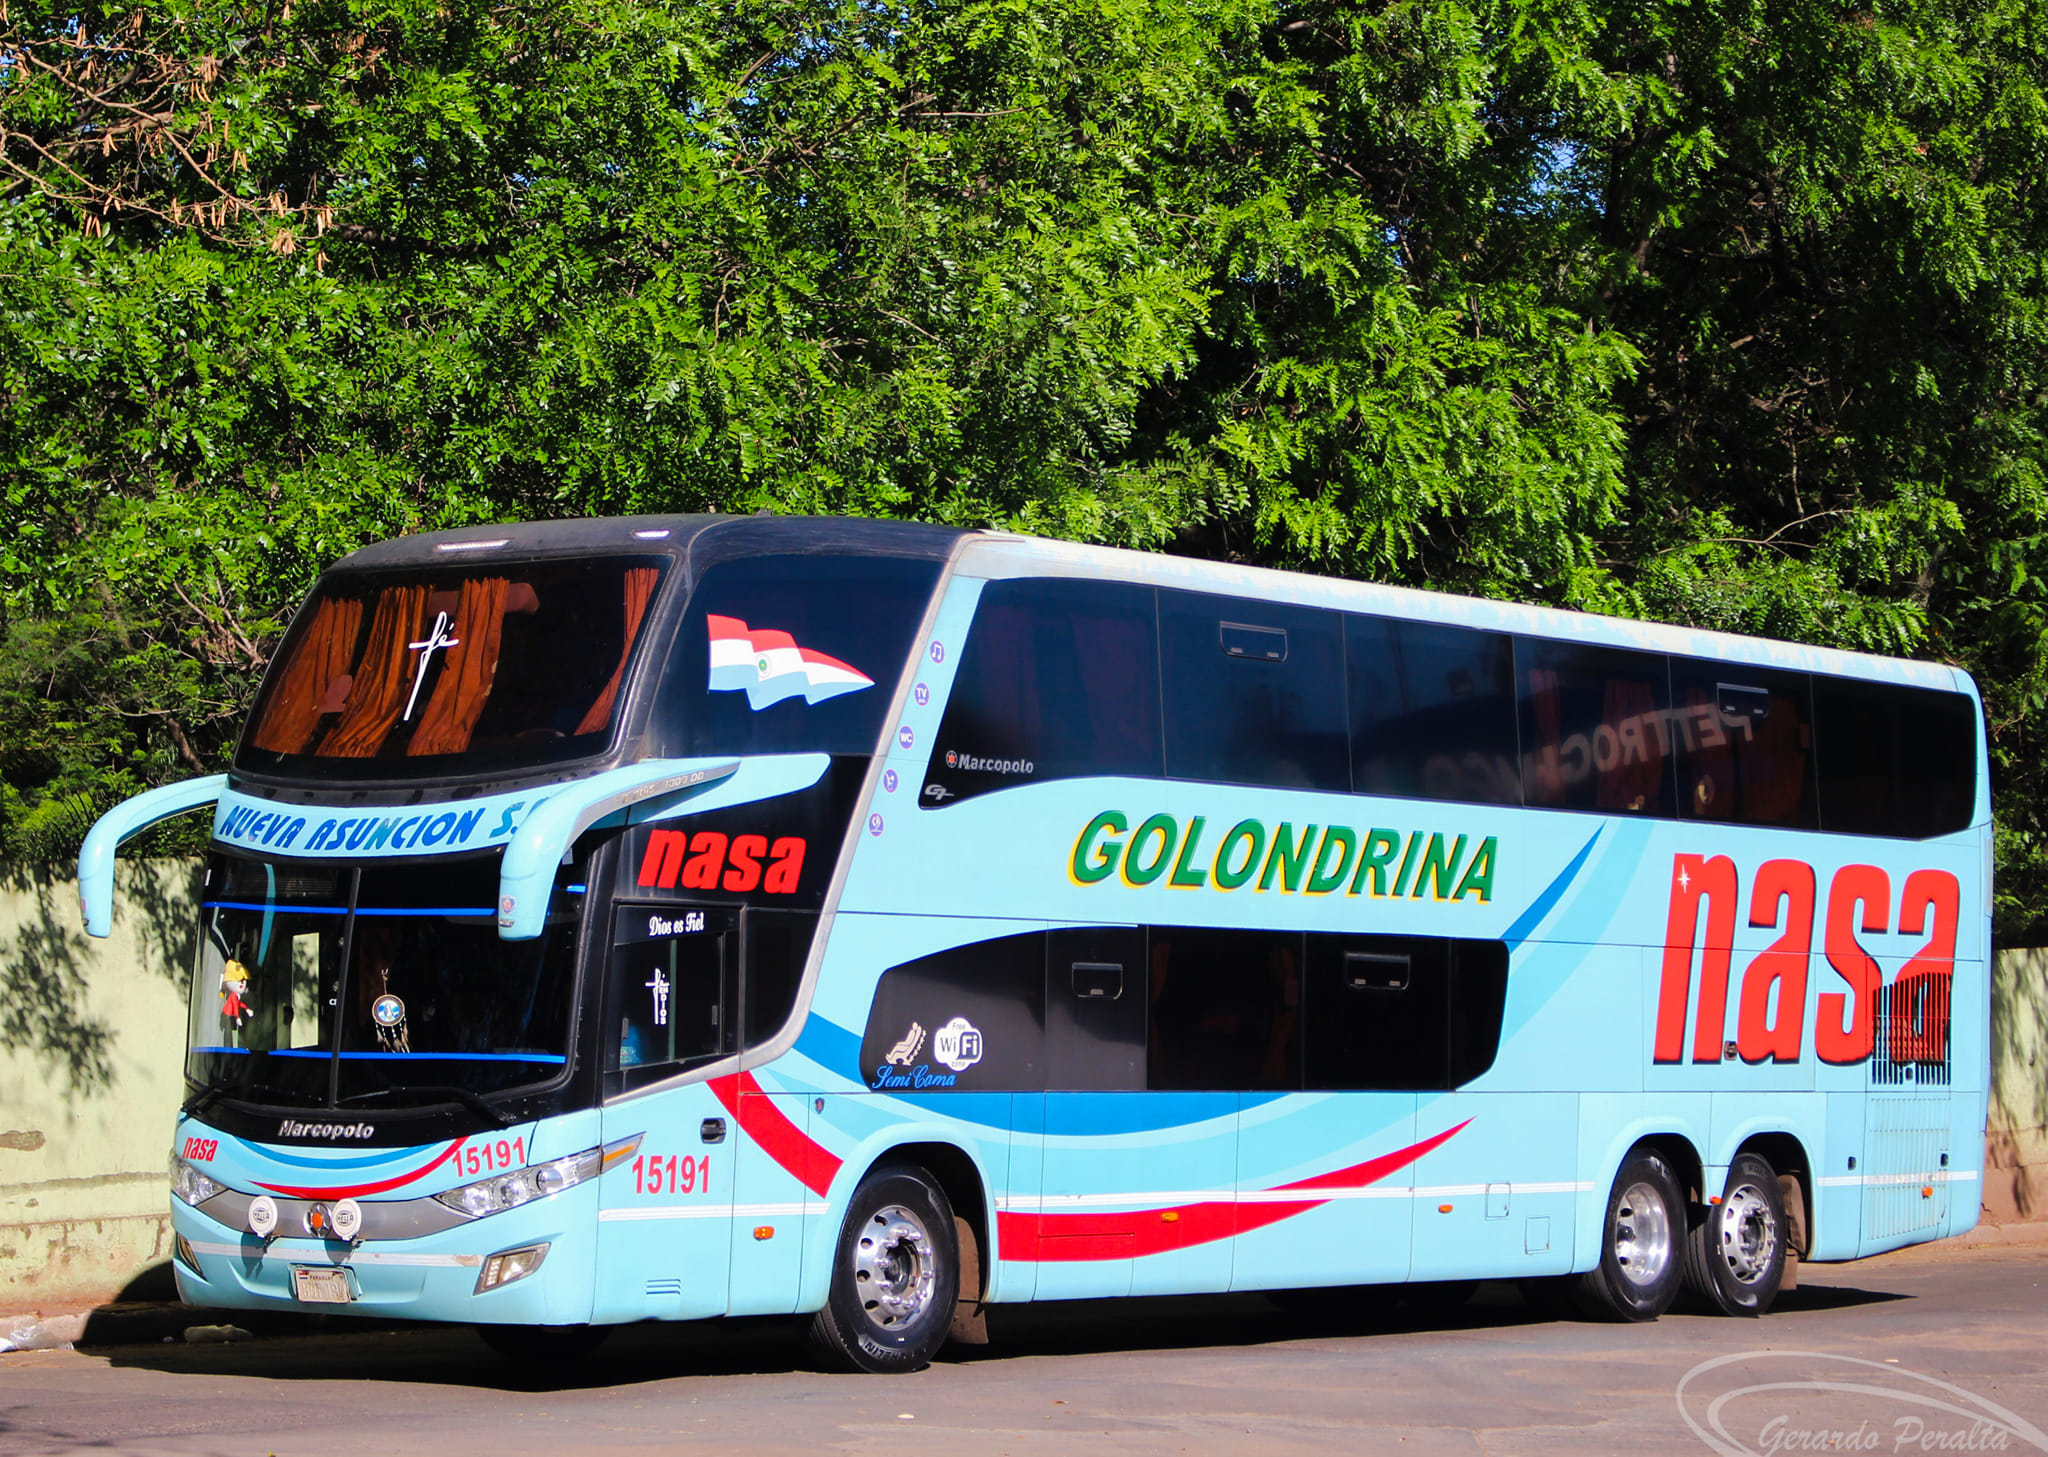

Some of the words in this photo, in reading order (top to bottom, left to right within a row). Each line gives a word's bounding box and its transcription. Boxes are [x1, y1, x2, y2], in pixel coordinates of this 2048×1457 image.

[916, 687, 928, 697] TV
[900, 733, 913, 743] WC
[958, 754, 1034, 774] Marcopolo
[219, 804, 306, 849] NUEVA
[304, 807, 486, 851] ASUNCION
[636, 829, 807, 894] nasa
[1067, 810, 1498, 905] GOLONDRINA
[648, 915, 672, 936] Dios
[673, 920, 684, 934] es
[685, 912, 704, 932] Fiel
[1652, 852, 1960, 1067] nasa
[952, 1022, 966, 1031] Free
[940, 1034, 978, 1056] WiFi
[872, 1065, 911, 1089] Semi
[912, 1065, 957, 1089] Cama
[278, 1119, 375, 1140] Marcopolo
[182, 1137, 219, 1162] nasa
[451, 1136, 526, 1178] 15191
[632, 1155, 710, 1194] 15191
